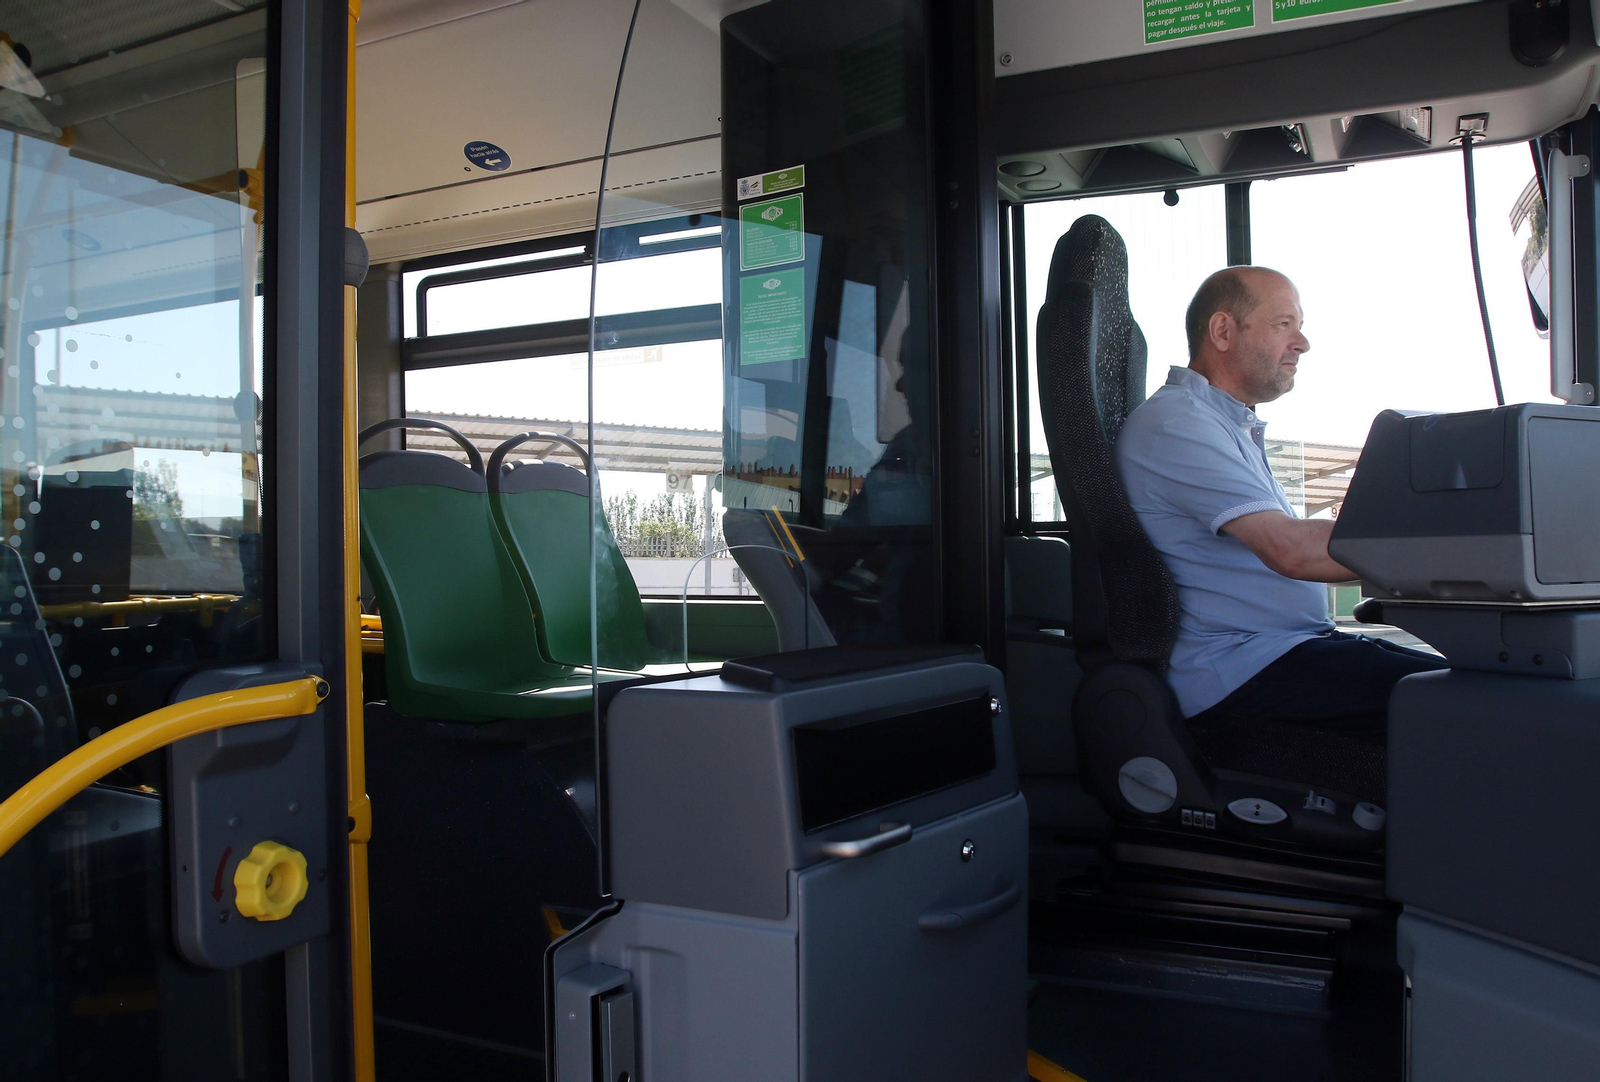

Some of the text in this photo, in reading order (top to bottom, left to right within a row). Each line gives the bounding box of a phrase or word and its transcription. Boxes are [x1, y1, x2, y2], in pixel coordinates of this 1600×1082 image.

[1147, 4, 1251, 28] recargar antes la tarjeta y
[1158, 6, 1182, 15] tengan
[1184, 1, 1204, 11] saldo
[1148, 30, 1168, 39] pagar
[1168, 23, 1198, 34] después
[1207, 19, 1226, 28] viaje.
[667, 473, 691, 490] 97
